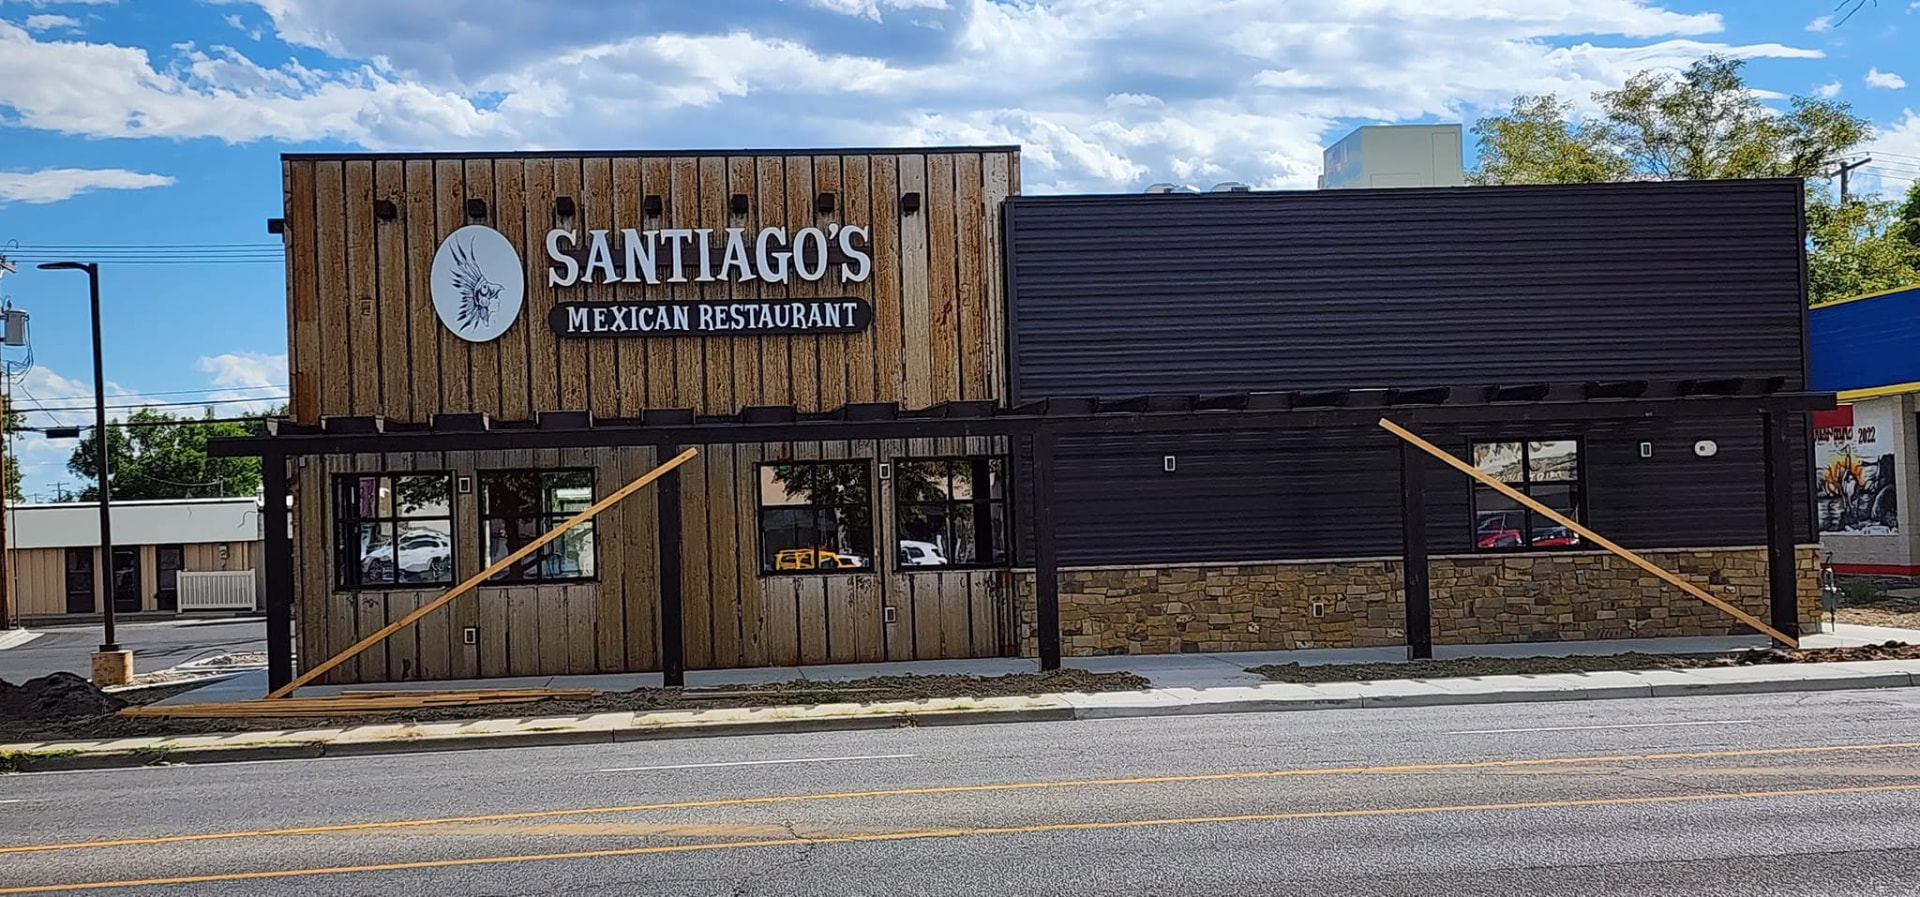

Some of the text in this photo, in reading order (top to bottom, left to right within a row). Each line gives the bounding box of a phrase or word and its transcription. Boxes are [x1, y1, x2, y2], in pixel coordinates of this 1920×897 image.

[546, 223, 871, 287] SANTIAGO'S
[566, 302, 857, 333] MEXICAN RESTAURANT
[1858, 426, 1876, 444] 2022
